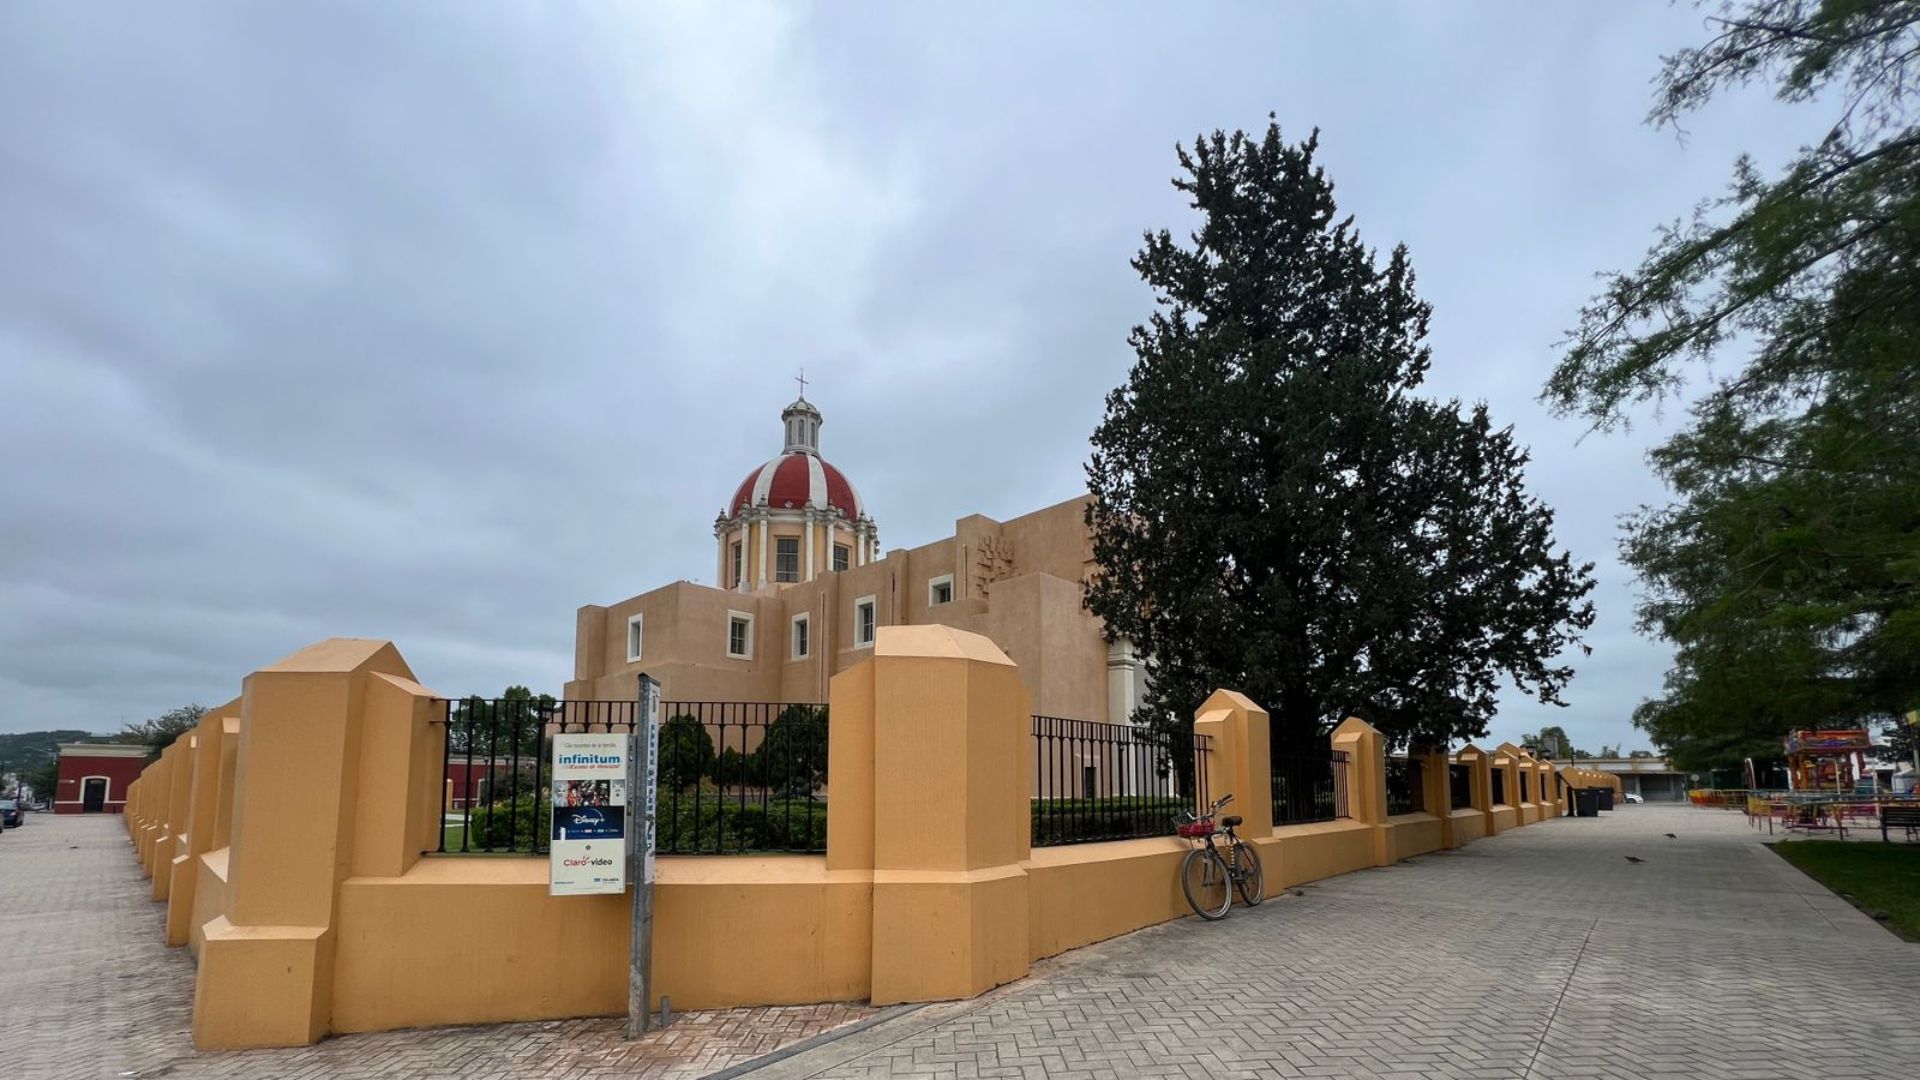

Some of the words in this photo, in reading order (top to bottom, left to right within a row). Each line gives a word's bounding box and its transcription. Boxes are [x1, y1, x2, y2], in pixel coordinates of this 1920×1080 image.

[559, 754, 621, 764] infinitum
[564, 857, 588, 866] Claro
[590, 858, 613, 866] video
